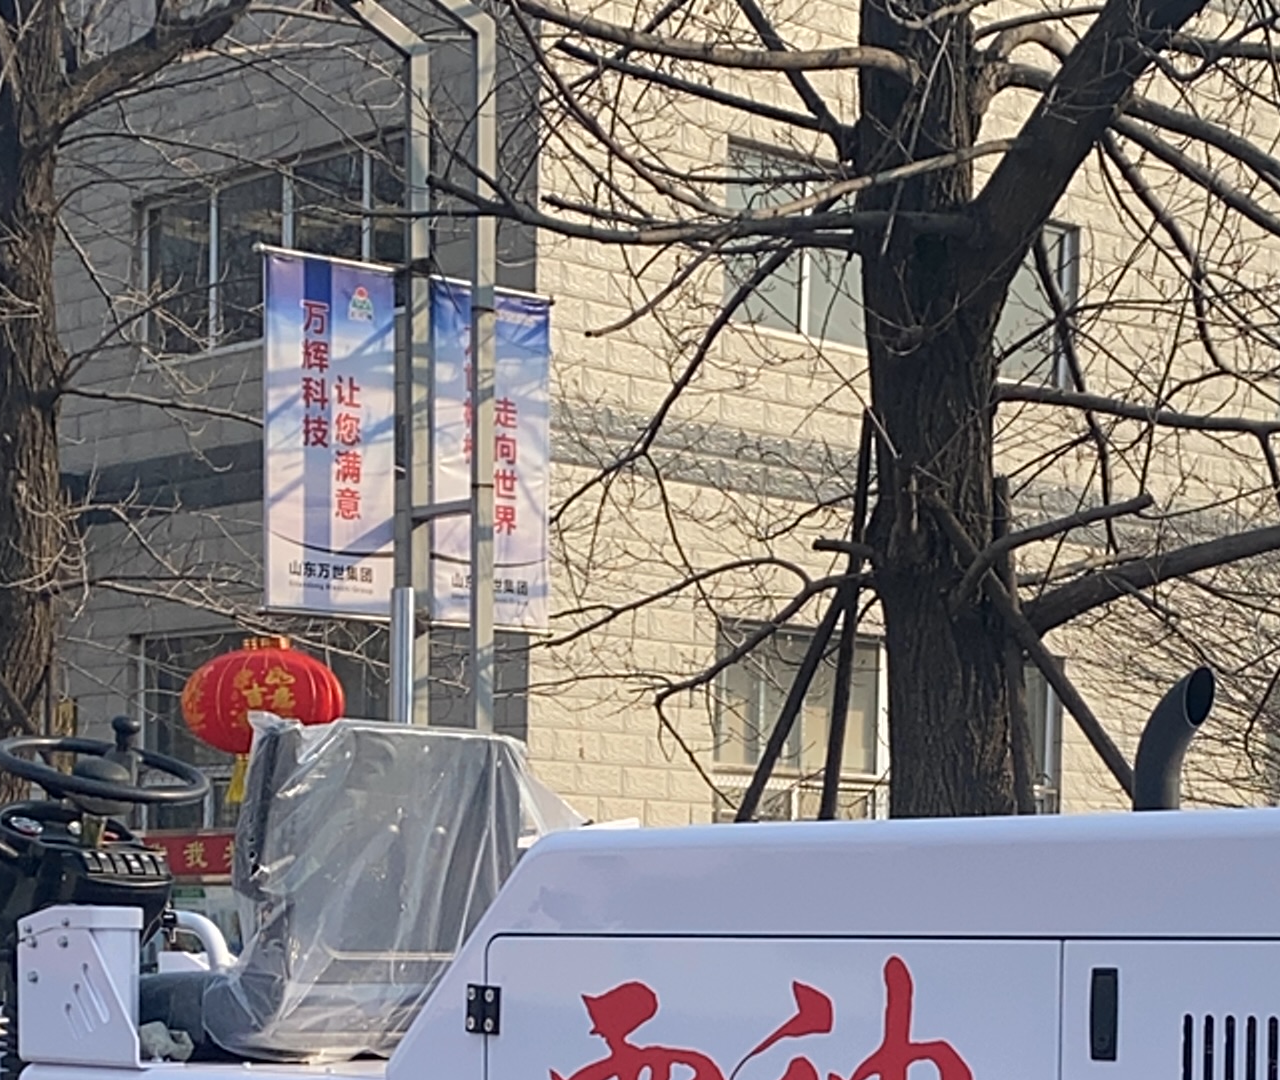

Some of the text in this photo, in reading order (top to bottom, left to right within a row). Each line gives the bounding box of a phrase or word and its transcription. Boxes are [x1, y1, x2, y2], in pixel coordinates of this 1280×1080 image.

[302, 300, 329, 448] 万辉科技
[335, 375, 361, 521] 让您满意
[494, 397, 517, 536] 走向世界
[289, 561, 373, 584] 山东万世集团
